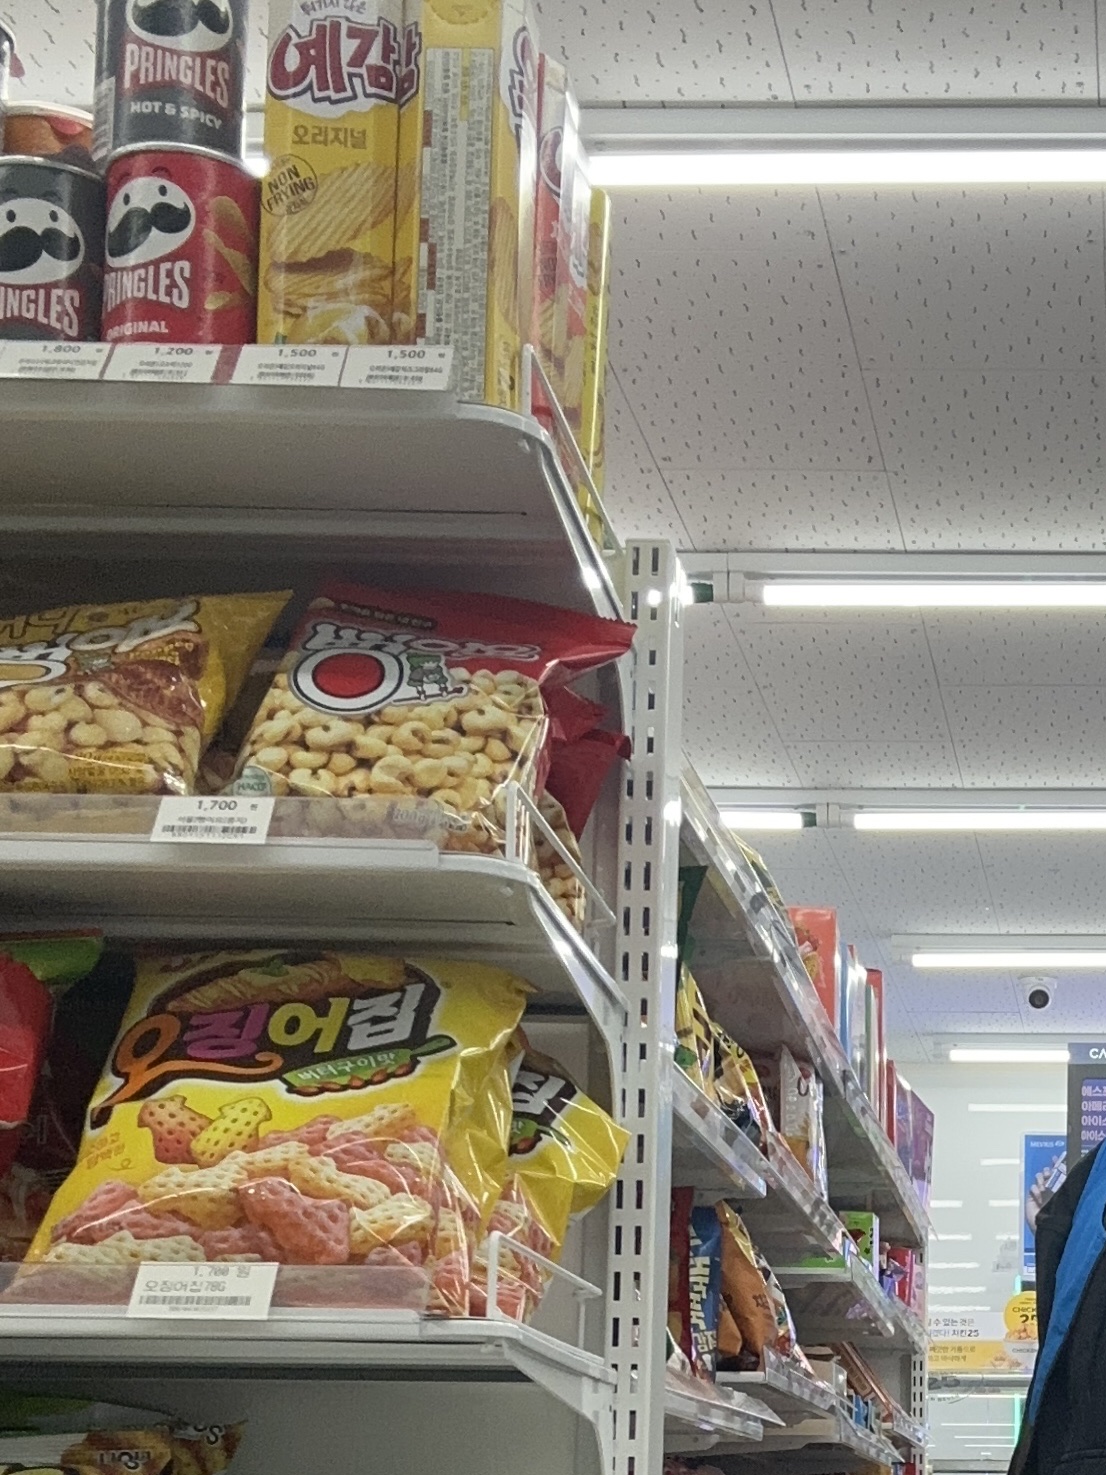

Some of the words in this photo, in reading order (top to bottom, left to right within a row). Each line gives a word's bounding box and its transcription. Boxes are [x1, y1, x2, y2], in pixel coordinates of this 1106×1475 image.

[268, 17, 402, 101] 예감
[124, 44, 230, 108] PRINGLES
[131, 100, 160, 115] HOT
[164, 101, 177, 116] &
[179, 105, 223, 130] SPICY
[291, 124, 368, 151] 오리지널
[266, 176, 316, 212] FRYING
[267, 164, 301, 195] NON
[0, 287, 80, 338] INGLES
[106, 320, 169, 341] ORIGINAL
[154, 347, 194, 356] 1,200
[277, 348, 318, 358] 1,500
[387, 349, 426, 360] 1,500
[197, 799, 239, 812] 1,700
[298, 1050, 396, 1082] 버터구이맛
